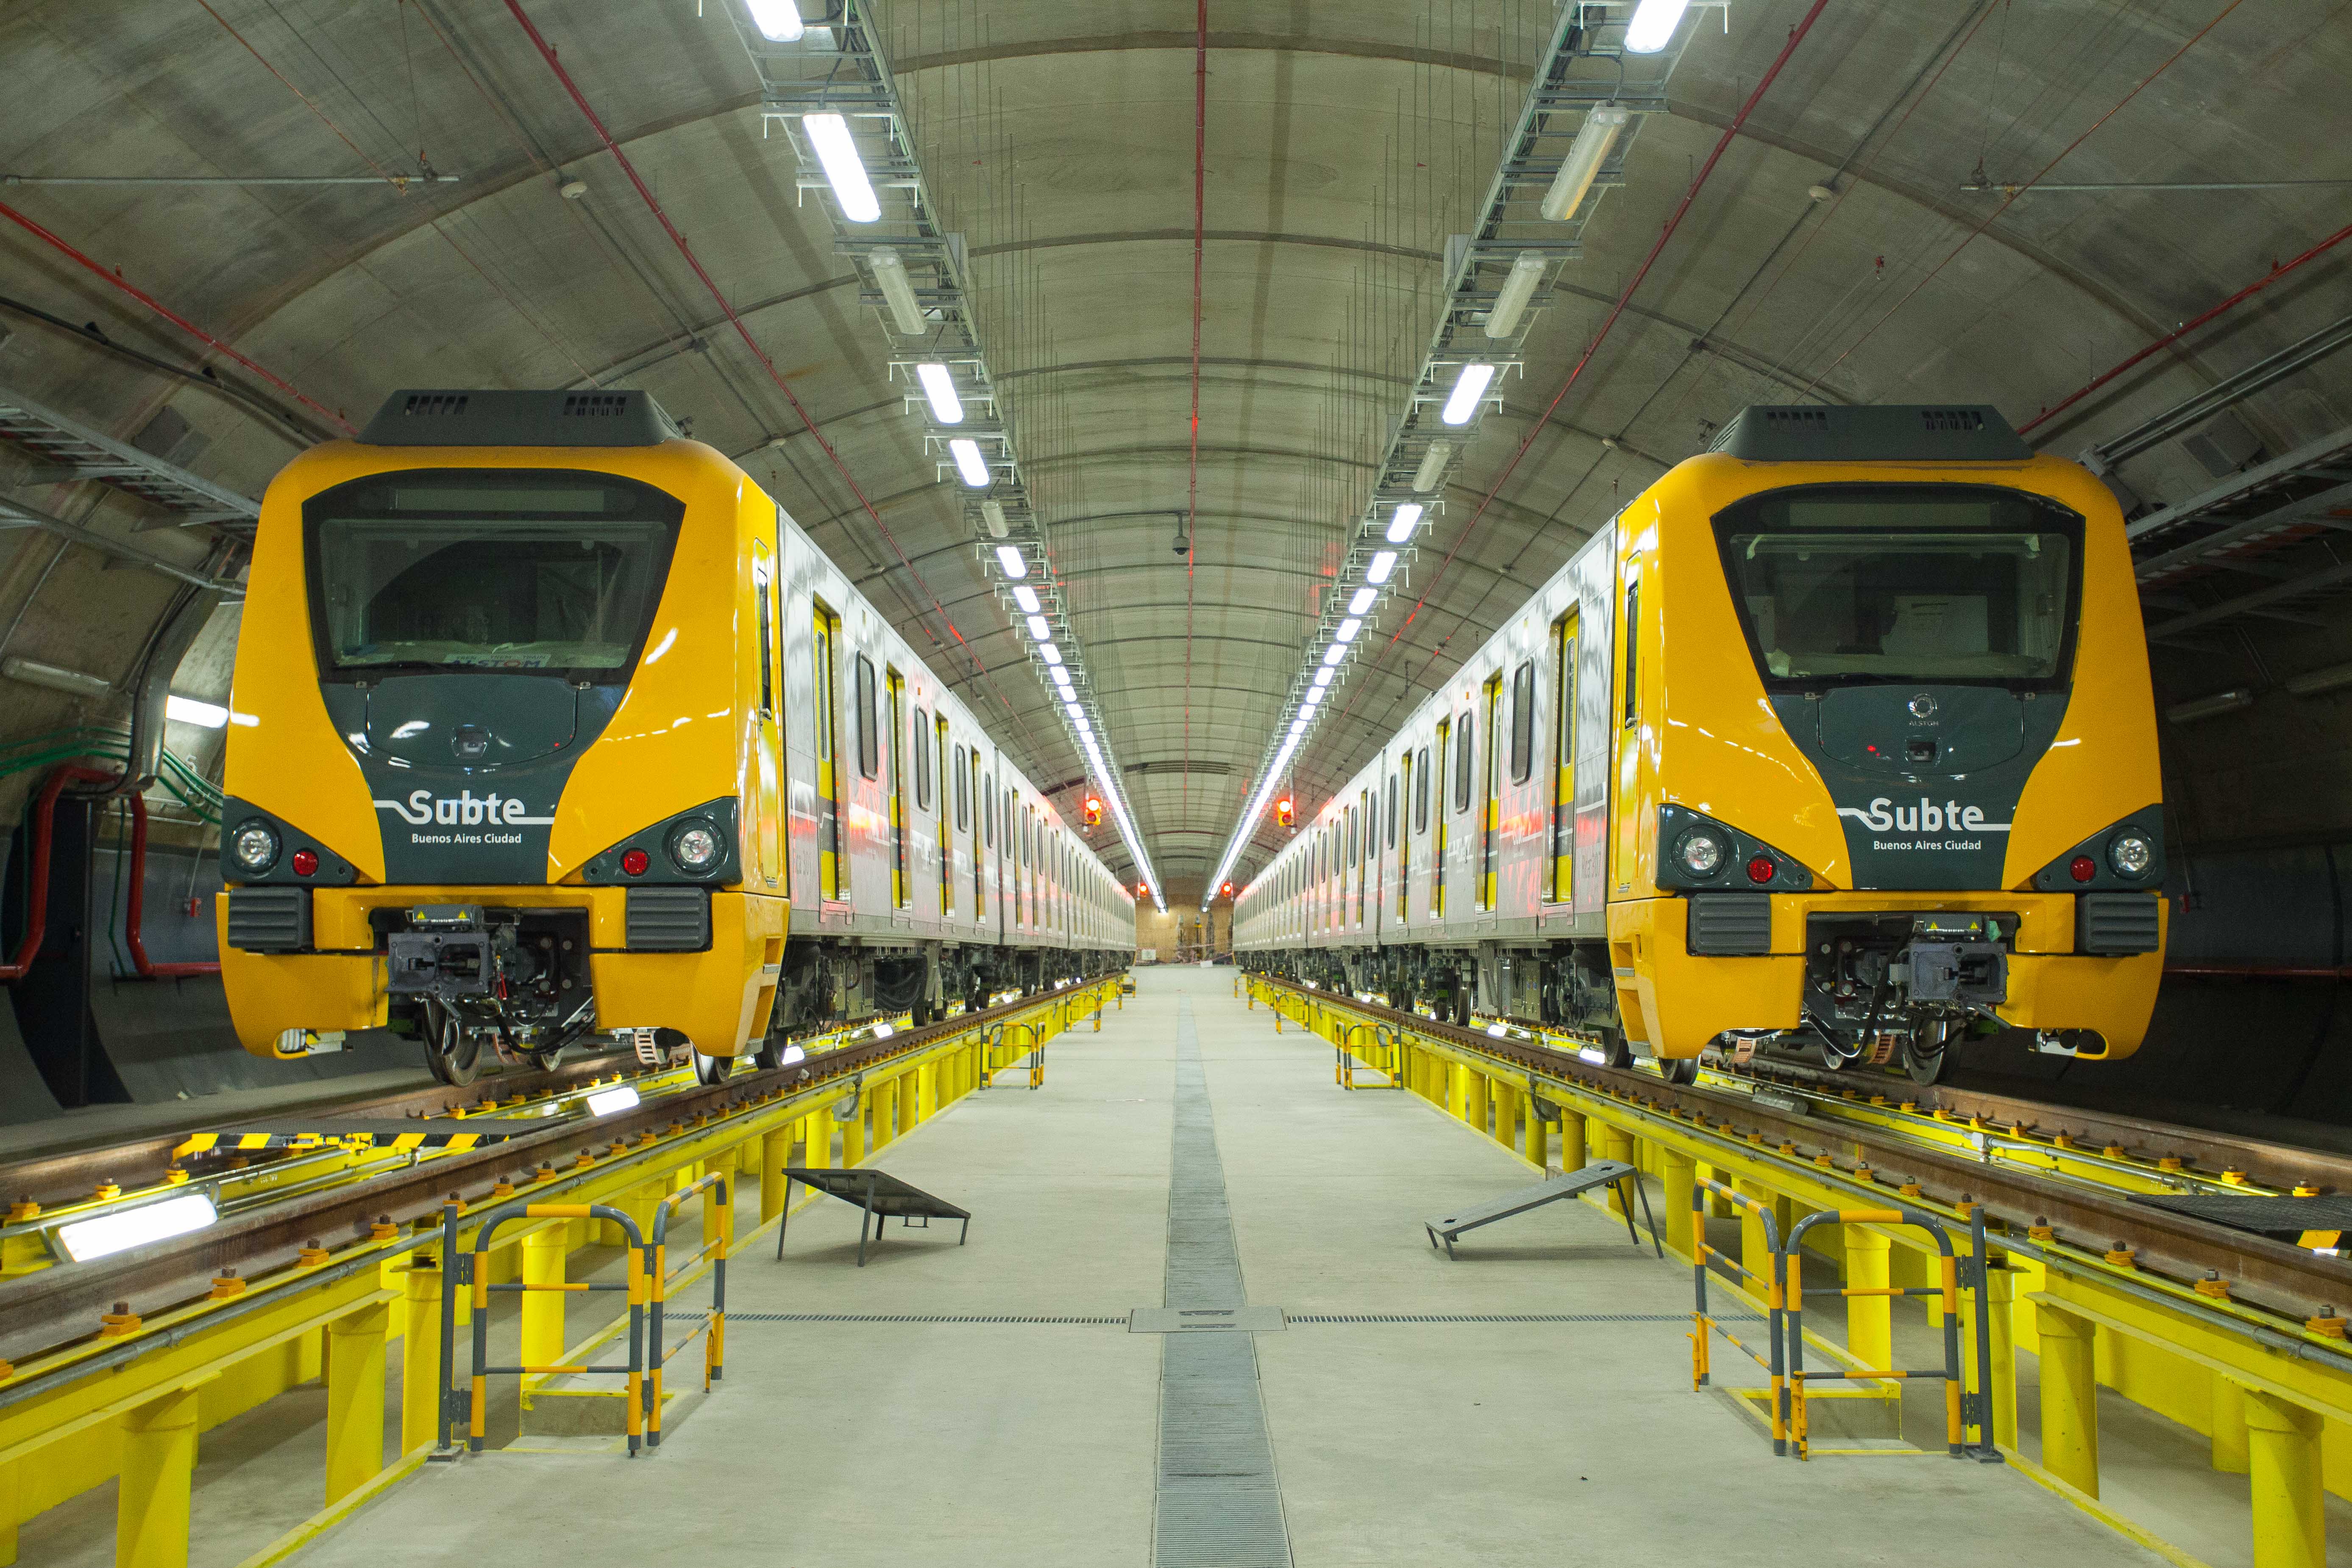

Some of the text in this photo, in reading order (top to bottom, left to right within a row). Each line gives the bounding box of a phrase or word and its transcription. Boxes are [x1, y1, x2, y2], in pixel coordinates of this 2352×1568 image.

[409, 789, 525, 825] Subte
[1870, 797, 1984, 832] Subte
[412, 833, 522, 844] Buenos Aires Ciudad
[1873, 840, 1982, 850] Buenos Aires Ciudad
